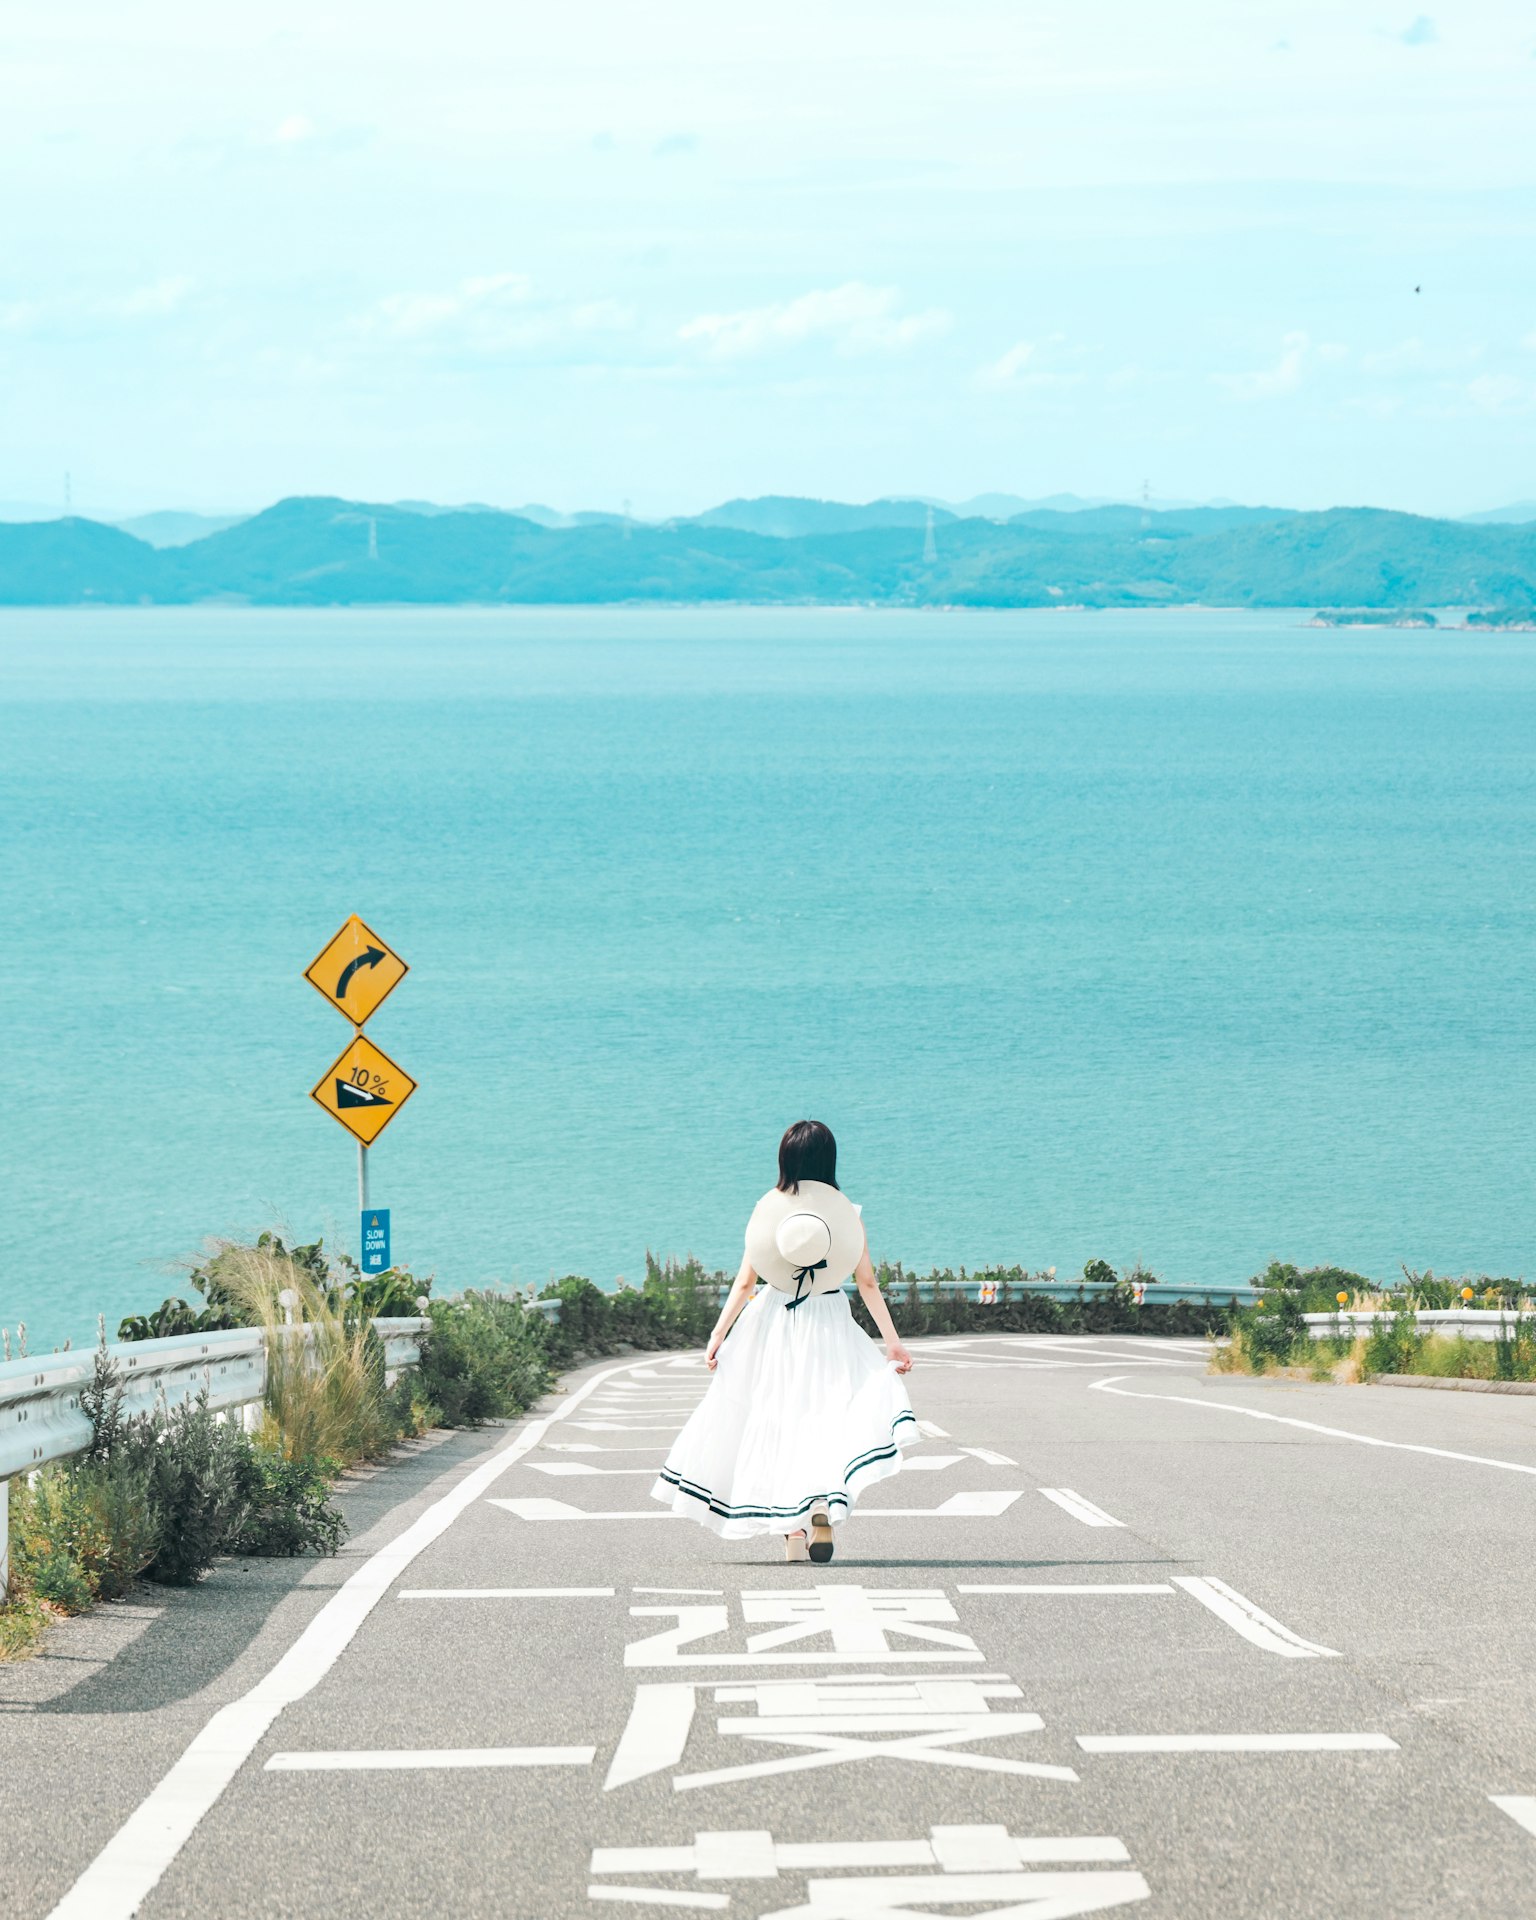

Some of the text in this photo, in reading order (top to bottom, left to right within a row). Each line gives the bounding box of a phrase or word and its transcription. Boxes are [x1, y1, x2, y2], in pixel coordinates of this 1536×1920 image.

[350, 1066, 389, 1096] 10%
[366, 1229, 385, 1240] SLOW
[365, 1240, 386, 1251] DOWN
